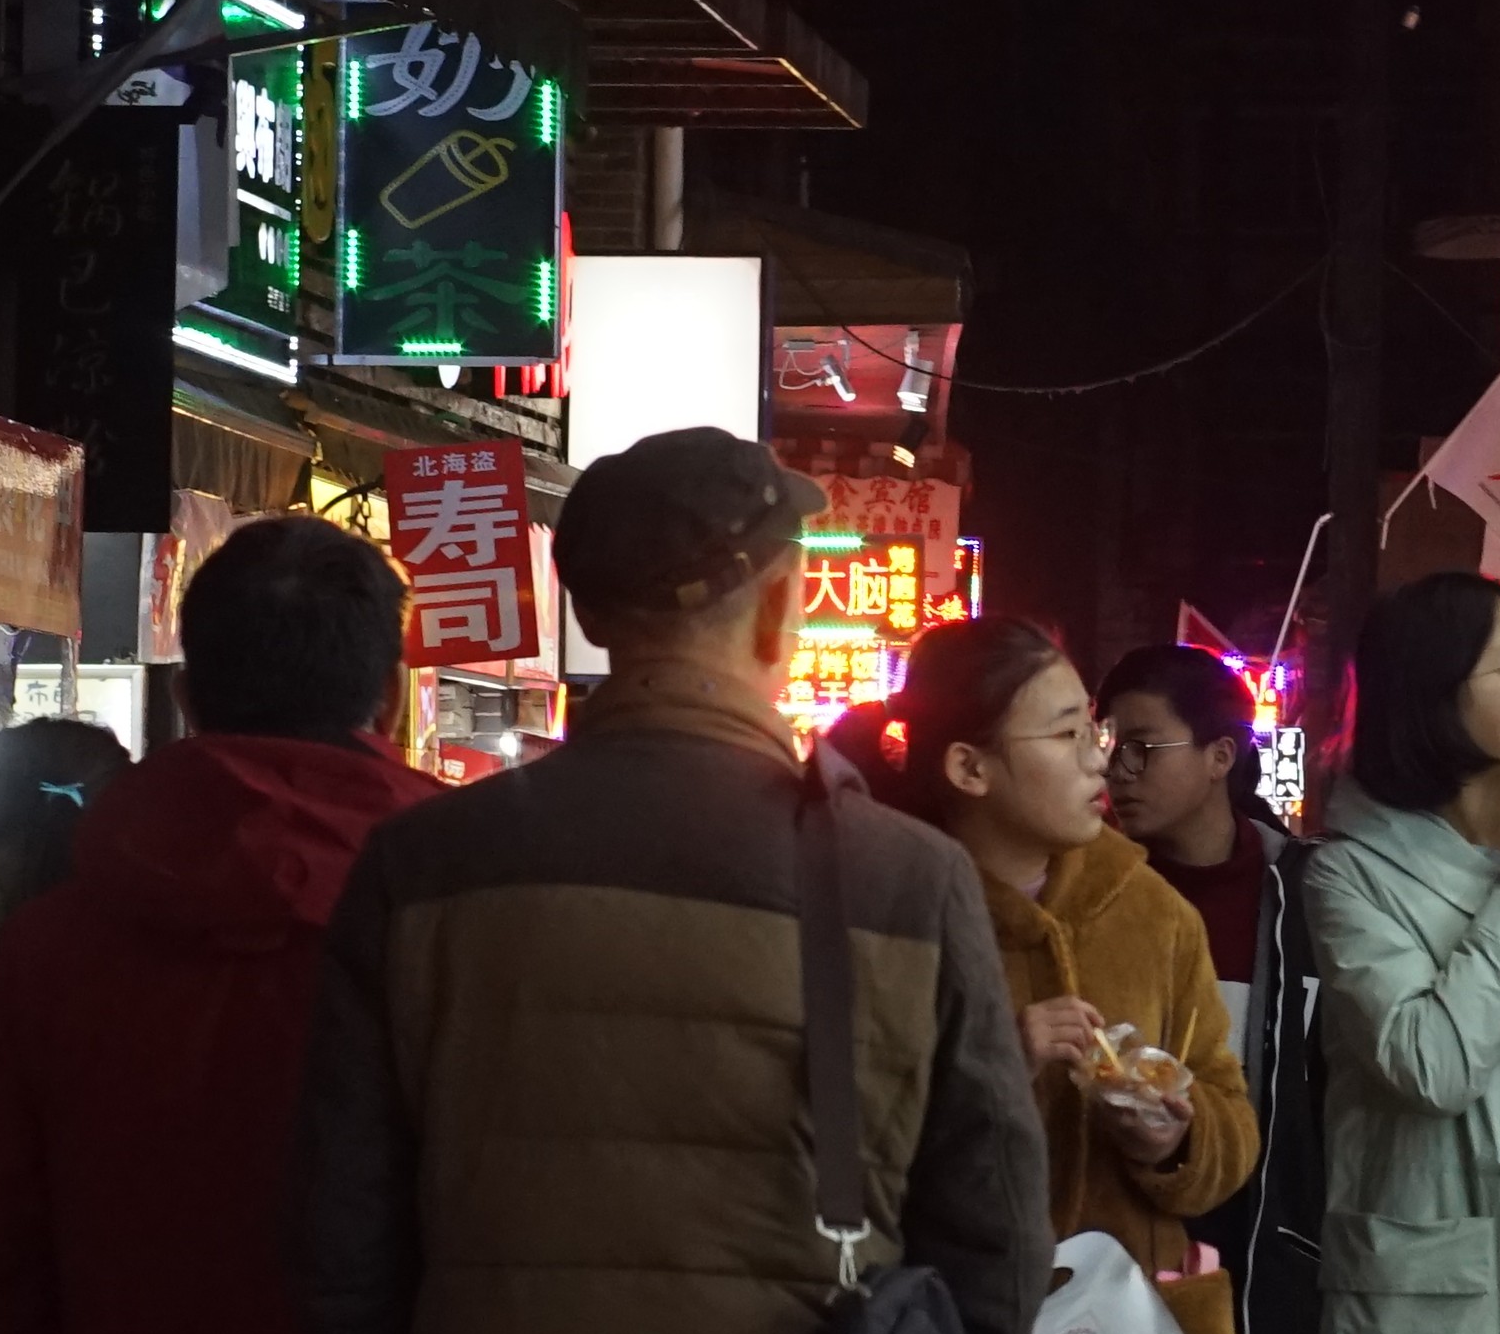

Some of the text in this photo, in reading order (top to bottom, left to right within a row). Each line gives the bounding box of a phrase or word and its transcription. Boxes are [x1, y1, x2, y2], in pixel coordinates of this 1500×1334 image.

[412, 451, 498, 478] 北海盗
[397, 480, 522, 652] 寿司
